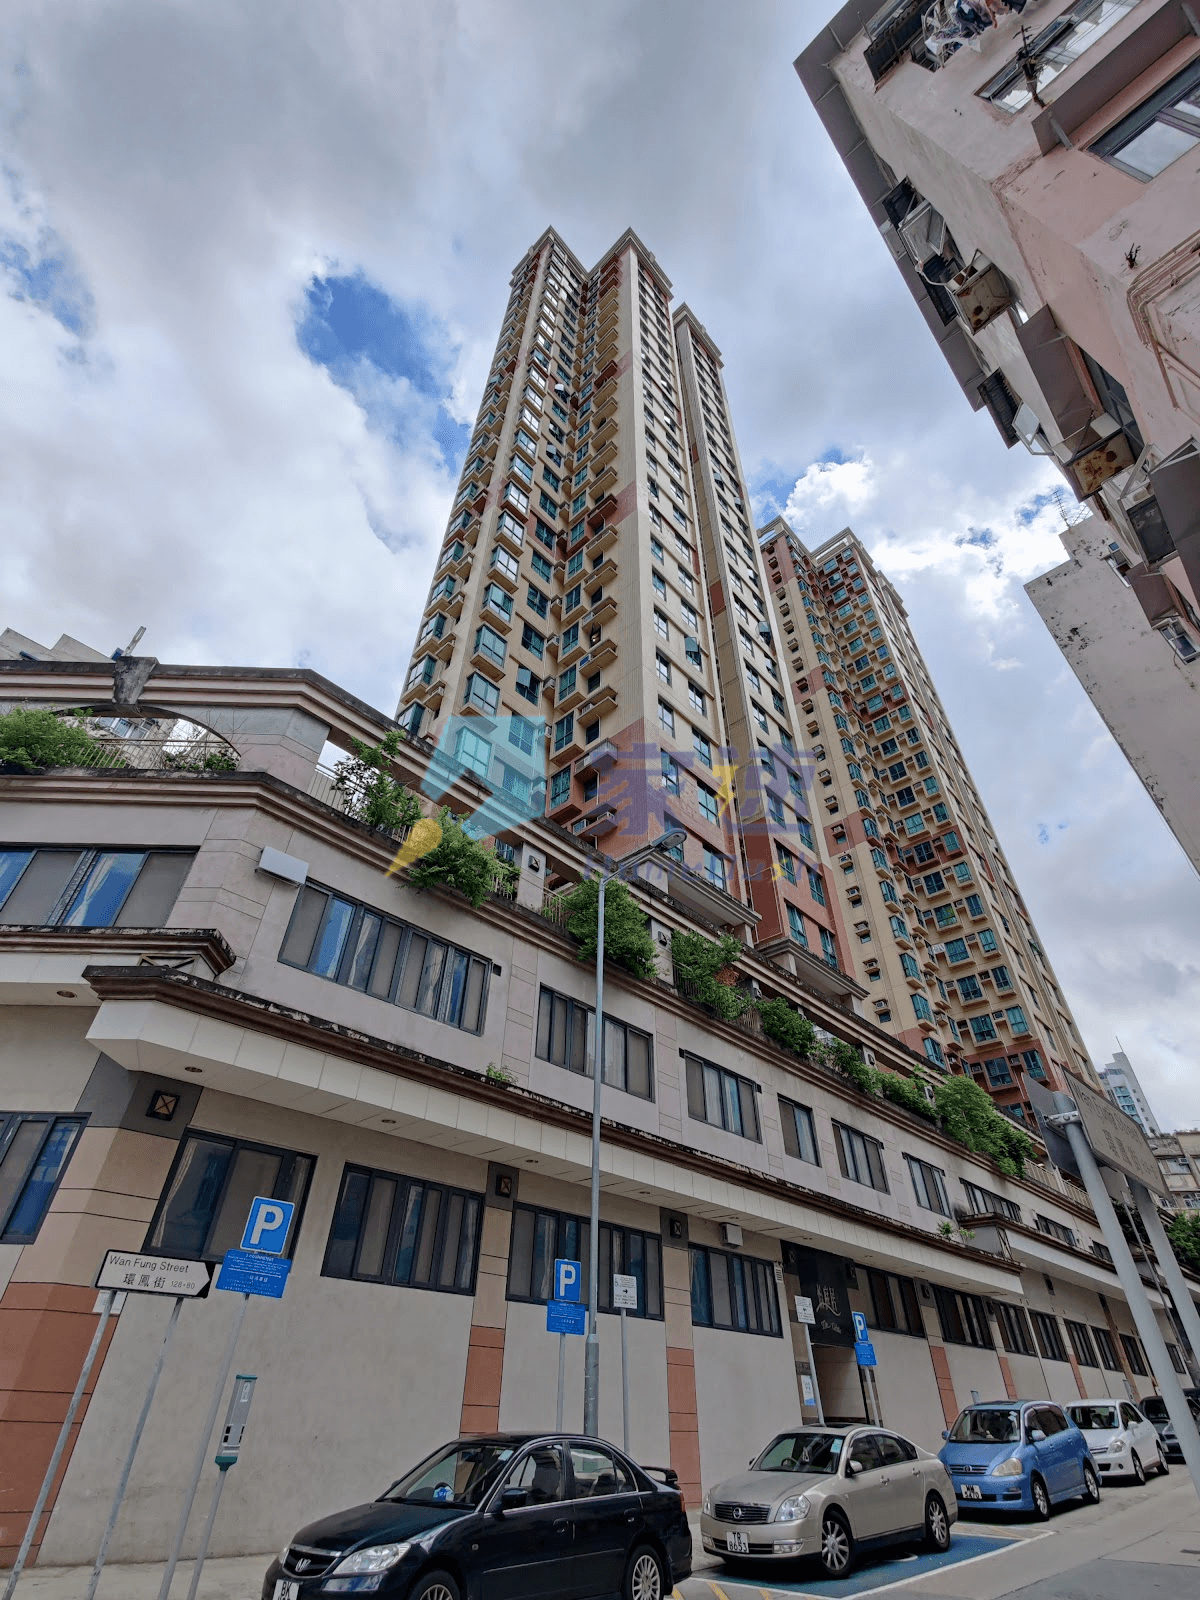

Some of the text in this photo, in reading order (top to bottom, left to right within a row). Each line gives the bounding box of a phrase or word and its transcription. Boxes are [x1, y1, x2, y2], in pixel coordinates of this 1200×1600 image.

[250, 1204, 284, 1244] P
[110, 1255, 189, 1273] Wan Fung Street
[560, 1264, 576, 1297] P
[855, 1314, 864, 1339] P
